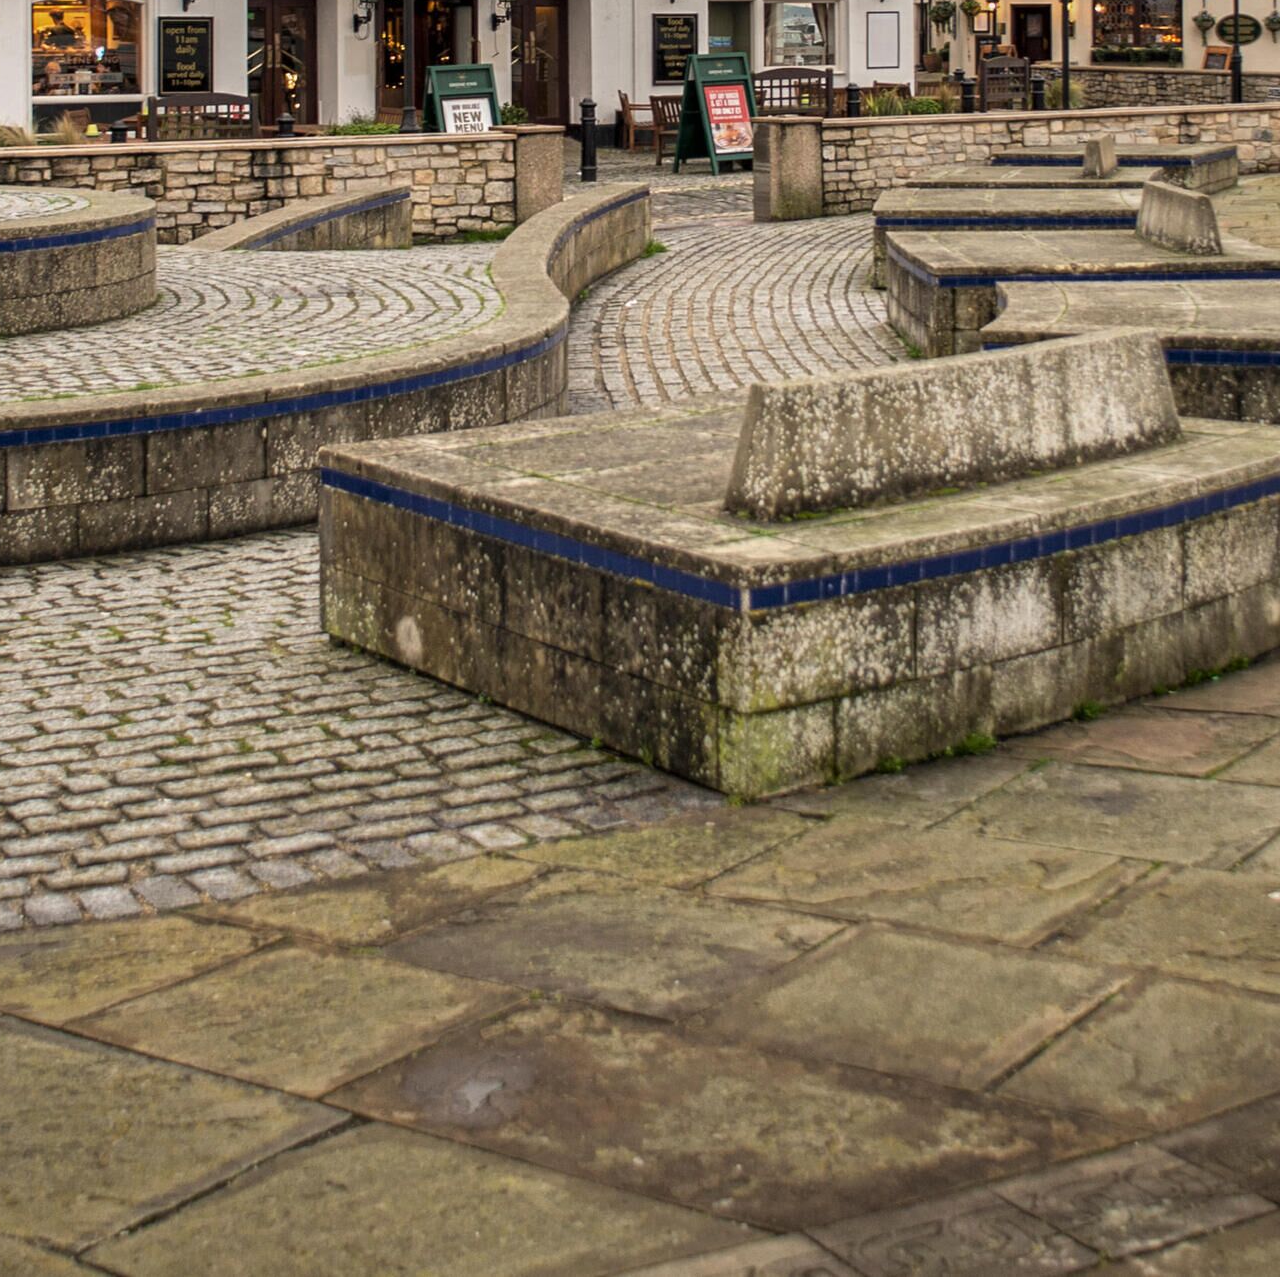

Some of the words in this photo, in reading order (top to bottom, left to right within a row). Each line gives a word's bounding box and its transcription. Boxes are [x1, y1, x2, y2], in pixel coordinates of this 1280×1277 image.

[667, 18, 684, 26] food
[165, 27, 186, 36] open
[187, 25, 207, 35] from
[175, 35, 199, 44] 11am
[175, 44, 197, 56] daily
[176, 61, 196, 71] food
[453, 111, 482, 124] NEW
[455, 123, 485, 133] MENU
